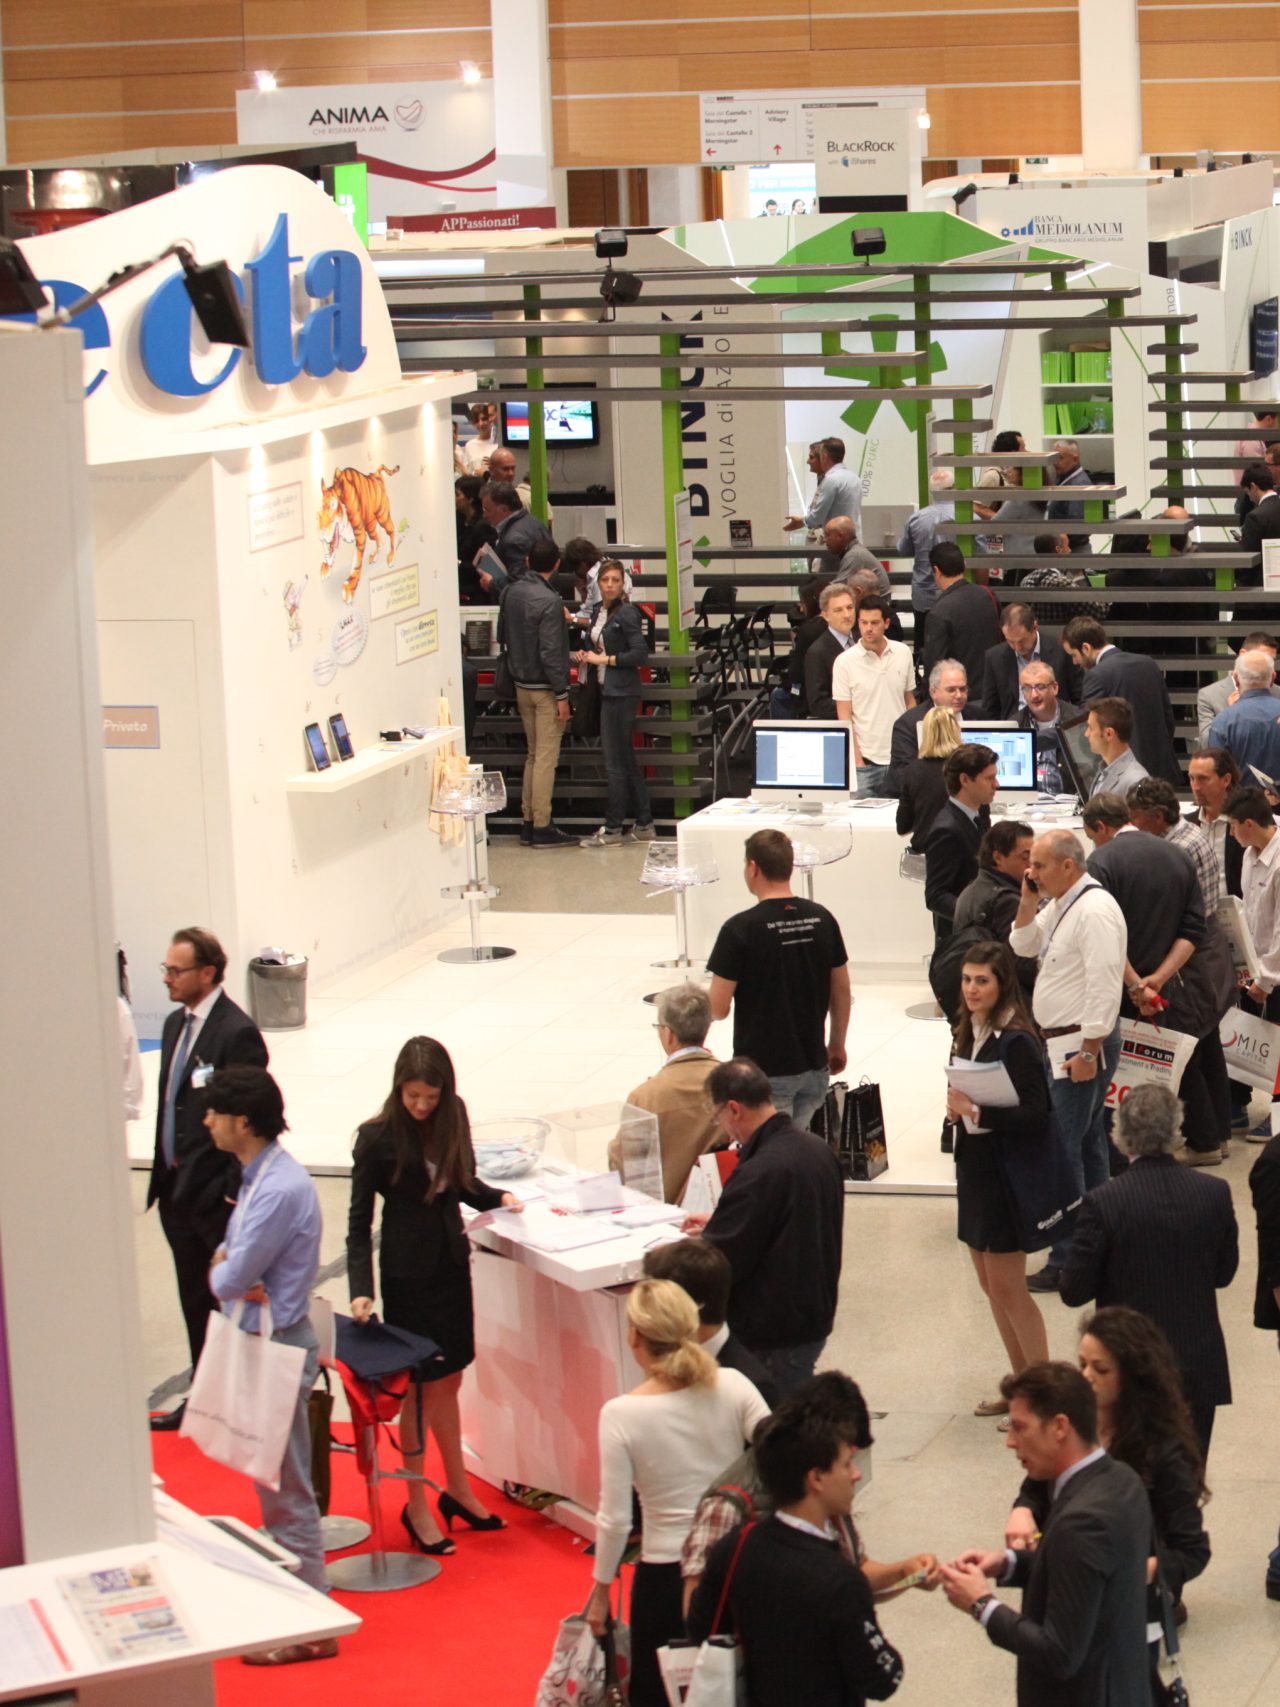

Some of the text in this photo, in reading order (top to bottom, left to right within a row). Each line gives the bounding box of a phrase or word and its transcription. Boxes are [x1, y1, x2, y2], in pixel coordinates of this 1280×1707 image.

[309, 106, 389, 126] ANIMA
[704, 117, 738, 126] Morningstar
[768, 116, 787, 124] Village
[705, 137, 738, 146] Morningstar
[441, 214, 520, 231] APPassionati!
[1034, 215, 1063, 224] BANCA
[1036, 222, 1123, 236] MEDIOLANUM
[719, 433, 737, 518] VOGLIA
[103, 719, 148, 733] Privato
[1237, 1033, 1270, 1058] MIG
